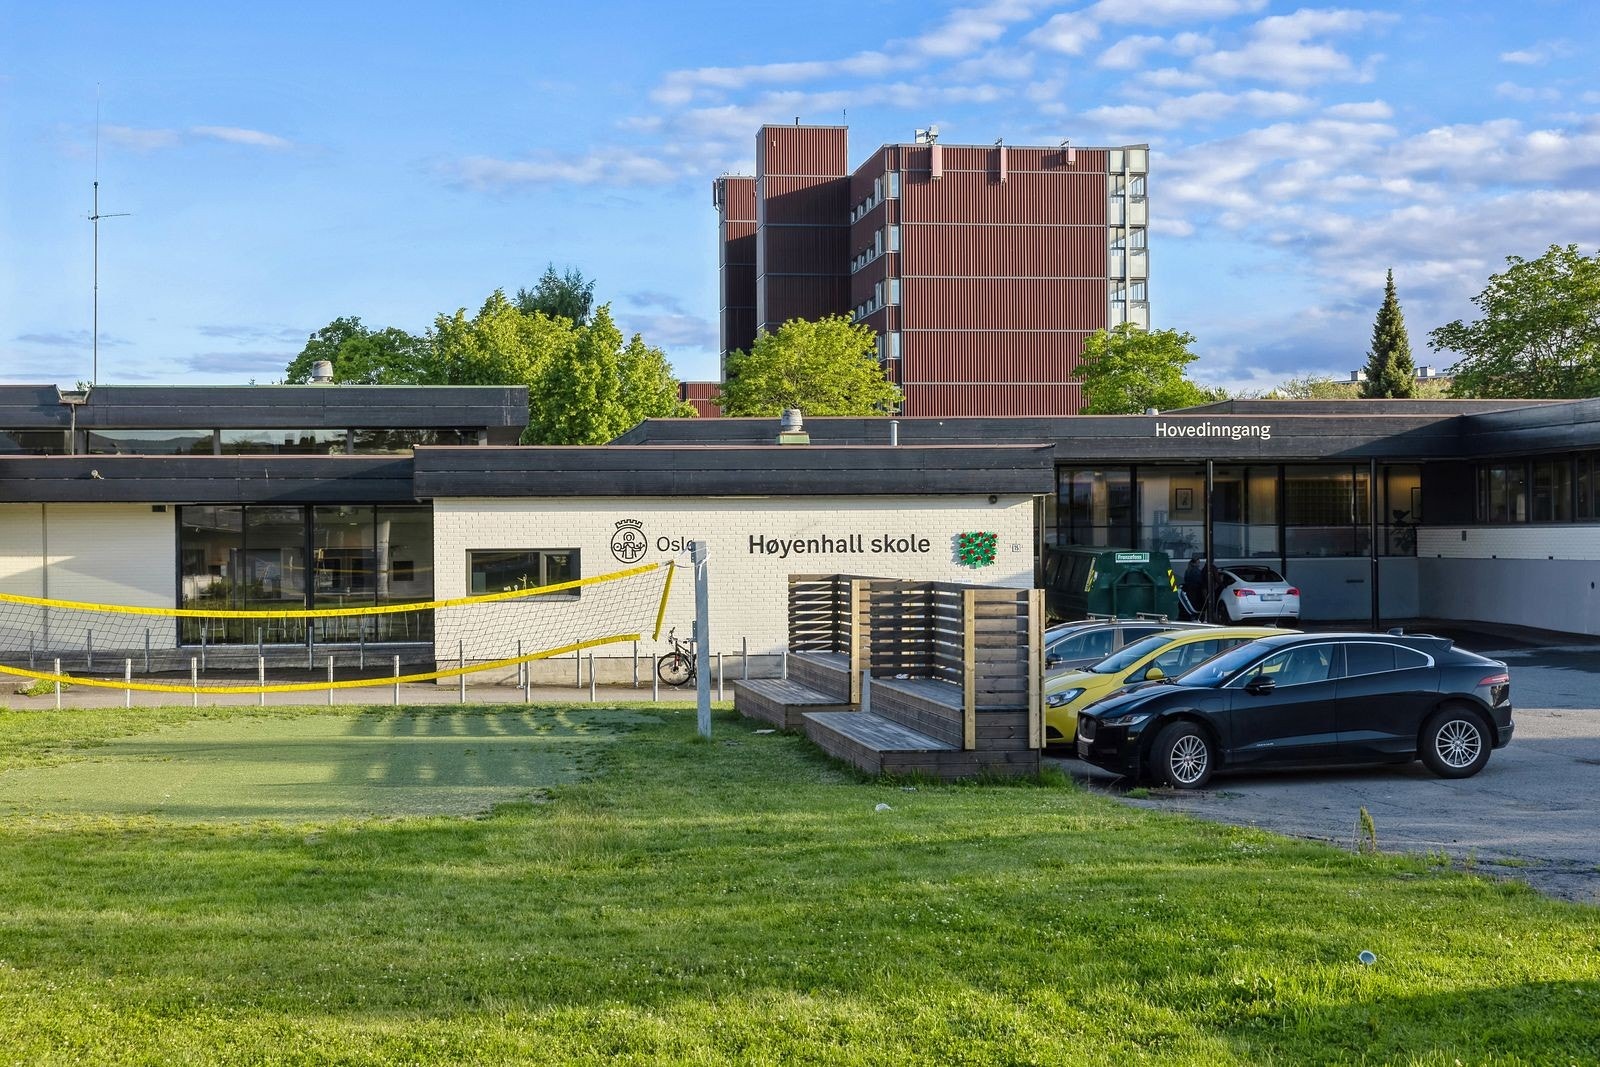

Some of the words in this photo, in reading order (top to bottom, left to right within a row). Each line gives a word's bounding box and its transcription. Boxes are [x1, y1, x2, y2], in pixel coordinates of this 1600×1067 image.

[1155, 421, 1271, 440] Hovedinngang
[749, 534, 864, 559] Høyenhall
[871, 534, 931, 553] skole
